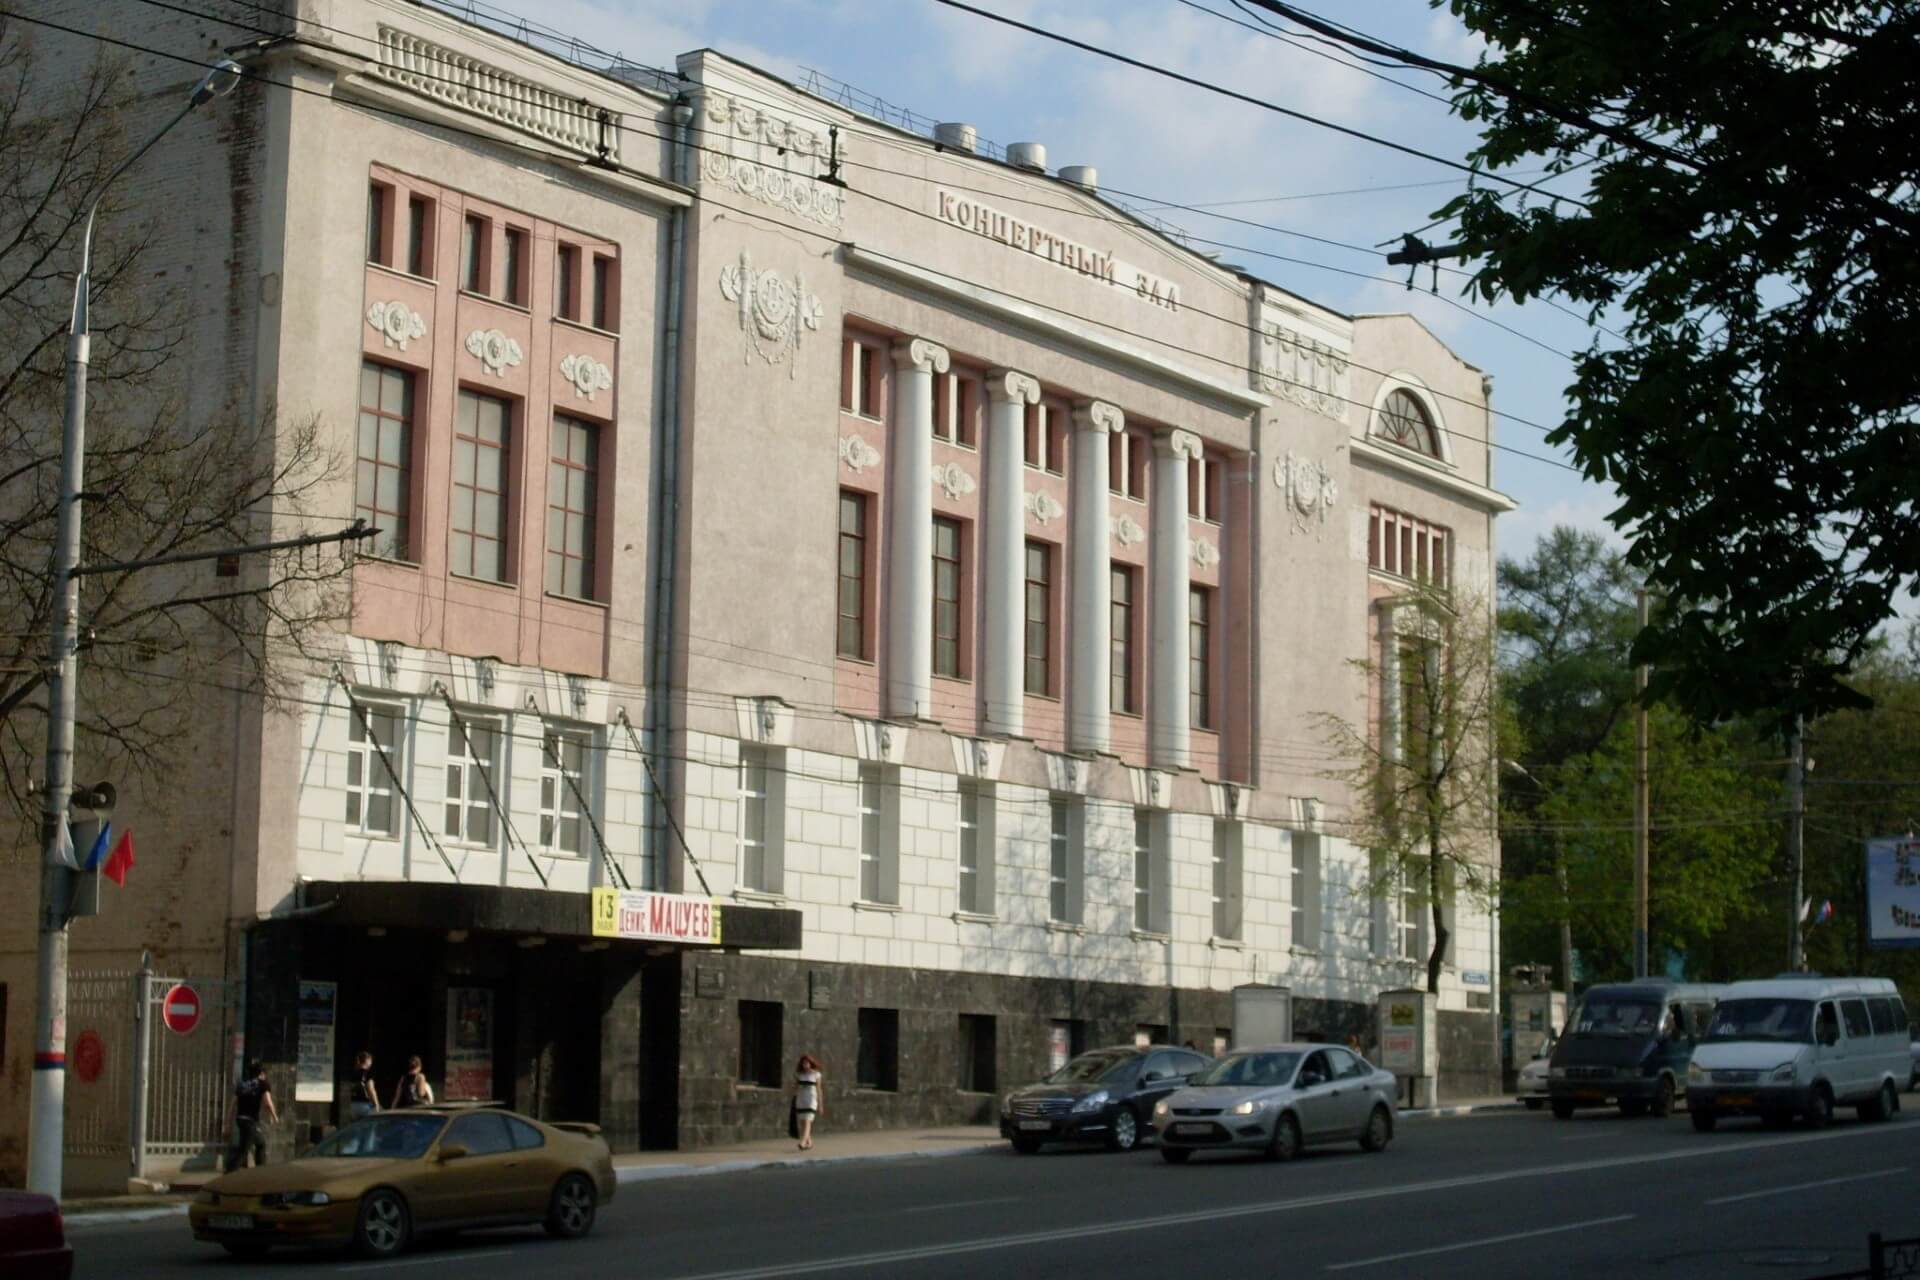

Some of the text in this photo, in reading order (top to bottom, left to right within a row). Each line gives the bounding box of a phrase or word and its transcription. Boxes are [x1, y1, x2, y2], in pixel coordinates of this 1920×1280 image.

[939, 190, 1178, 312] КОНЦЕРТНЫЙ ЗАЛ
[599, 894, 614, 919] 13
[650, 895, 710, 939] МАЦУЕВ
